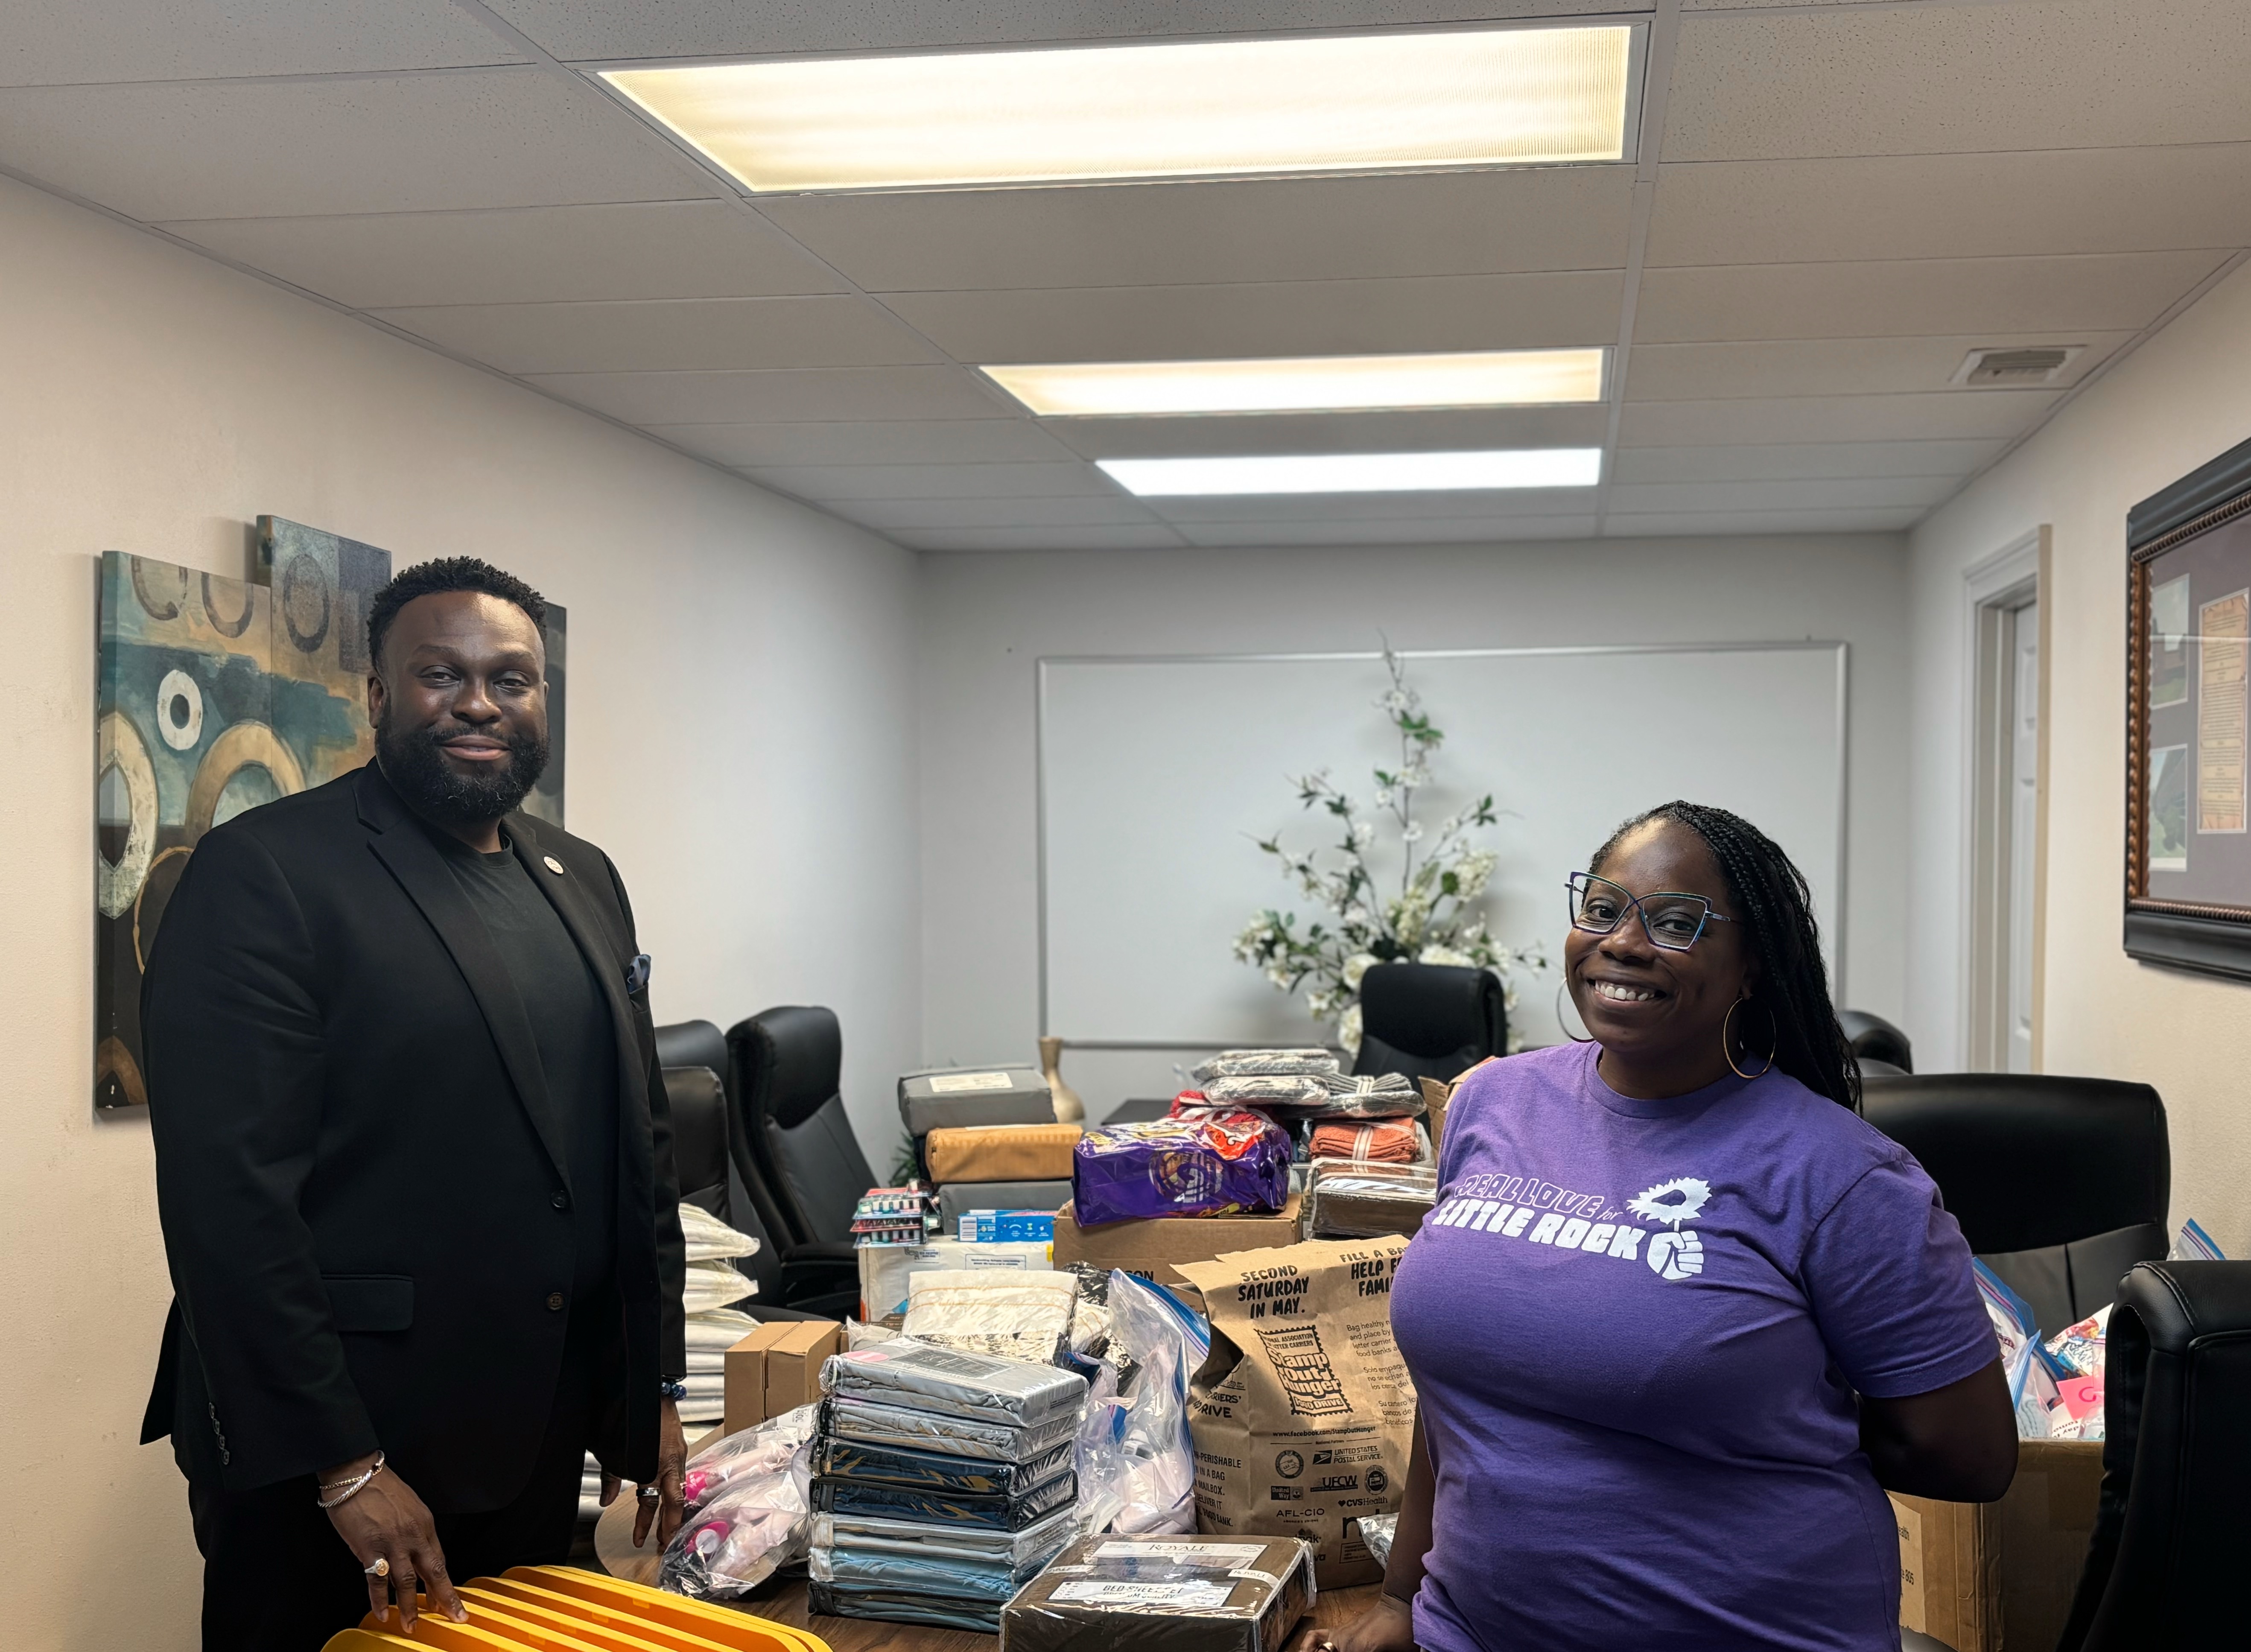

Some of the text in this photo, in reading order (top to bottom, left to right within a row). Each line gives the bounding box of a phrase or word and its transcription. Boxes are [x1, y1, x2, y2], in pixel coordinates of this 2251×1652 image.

[1454, 1174, 1623, 1220] REAL LOVE for
[1431, 1199, 1646, 1260] LITTLE ROCK
[1340, 1252, 1369, 1262] FILL
[1374, 1250, 1383, 1258] A
[1241, 1265, 1297, 1281] SECOND
[1351, 1260, 1384, 1279] HELP
[1238, 1276, 1309, 1301] SATURDAY
[1359, 1276, 1393, 1296] FAMI
[1250, 1297, 1305, 1319] IN MAY.
[1361, 1320, 1384, 1329] healthy
[1282, 1333, 1314, 1342] ASSOCIATION
[1363, 1331, 1381, 1340] place
[1371, 1338, 1391, 1346] carrier
[1372, 1347, 1392, 1355] banks
[1266, 1347, 1330, 1369] Stamp
[1284, 1367, 1323, 1381] Out
[1278, 1373, 1341, 1397] Hunger
[1398, 1379, 1409, 1388] del
[1313, 1398, 1343, 1409] DRIVE
[1207, 1469, 1211, 1477] A
[1212, 1471, 1225, 1480] BAG
[1322, 1475, 1357, 1487] UFCW
[1199, 1481, 1225, 1495] MAILBOX.
[1217, 1501, 1222, 1510] IT
[1346, 1496, 1387, 1507] CVSHealth
[1276, 1509, 1325, 1517] AFL-CIO
[1149, 1544, 1209, 1553] ROYALE
